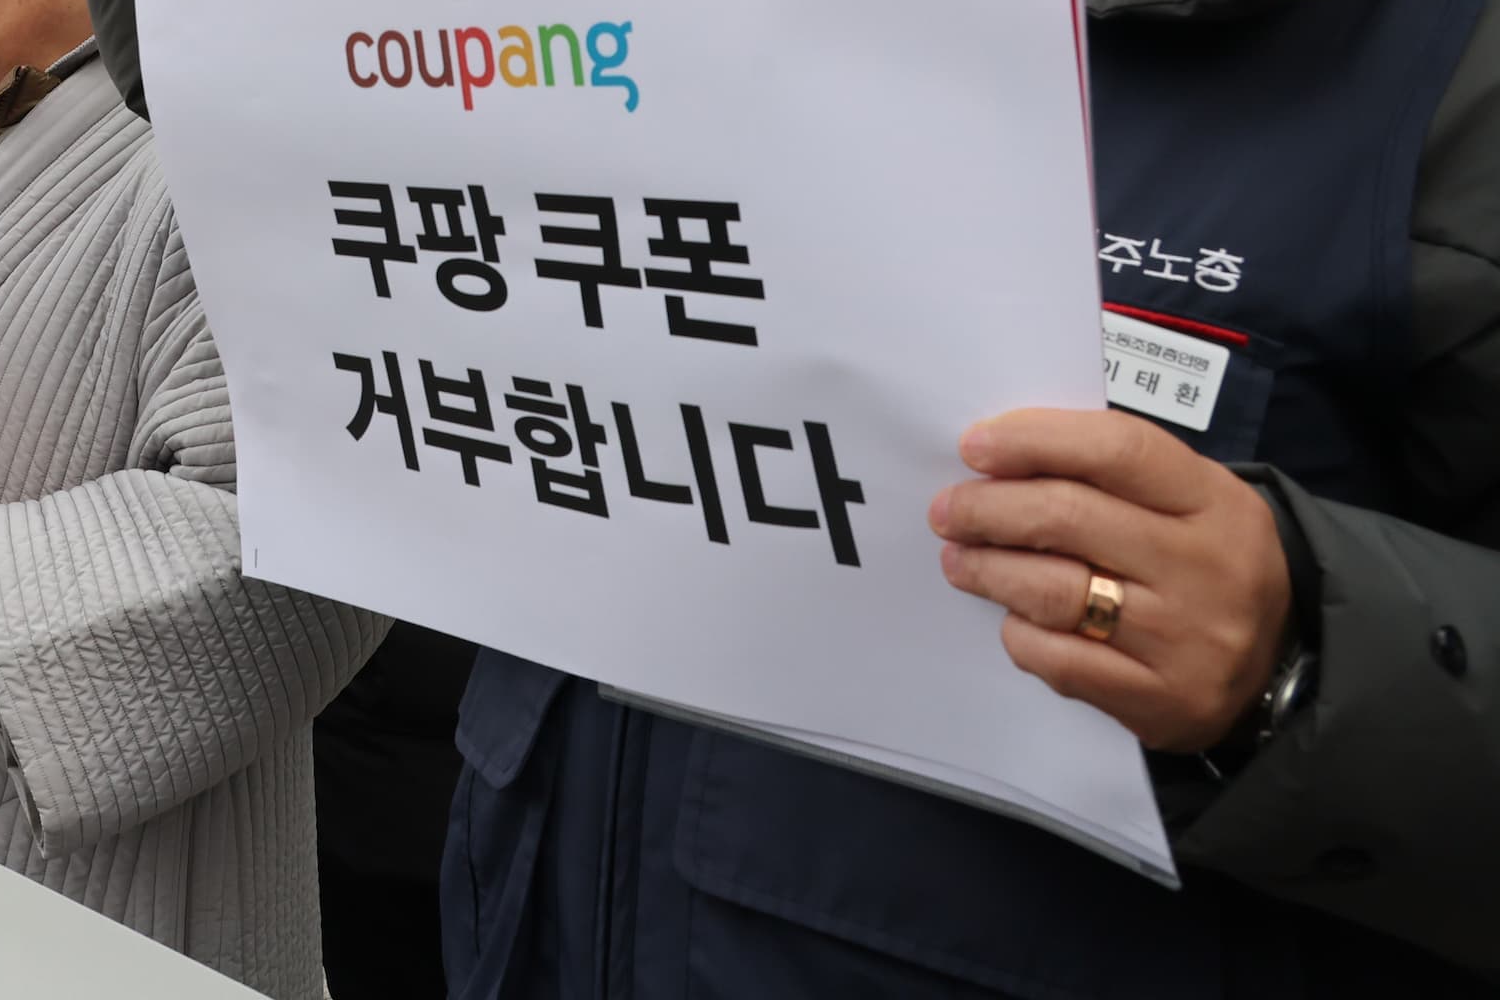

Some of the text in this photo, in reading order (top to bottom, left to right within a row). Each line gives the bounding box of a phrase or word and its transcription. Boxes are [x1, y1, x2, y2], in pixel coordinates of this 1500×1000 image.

[345, 20, 639, 113] coupang
[327, 180, 766, 348] 쿠팡 쿠폰
[1097, 232, 1245, 293] 주노총
[332, 350, 866, 568] 거부합니다
